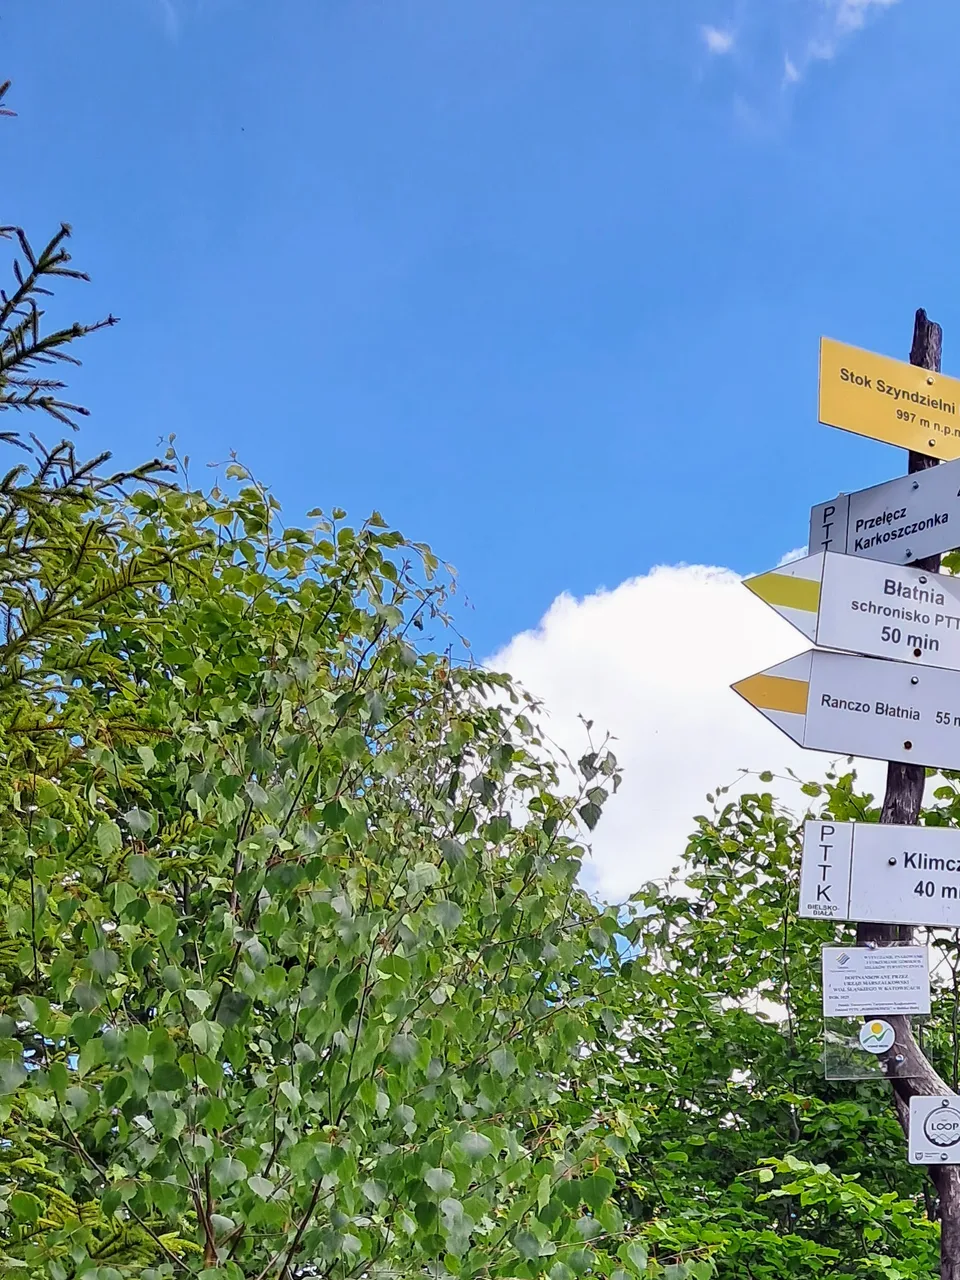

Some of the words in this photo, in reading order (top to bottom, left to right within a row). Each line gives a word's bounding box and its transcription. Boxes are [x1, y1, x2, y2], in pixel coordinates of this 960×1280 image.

[839, 367, 872, 390] Stok
[876, 379, 956, 416] Szyndzielni
[896, 409, 917, 424] 997
[919, 417, 931, 429] m
[821, 505, 836, 550] PTT
[854, 512, 949, 552] Karkoszczonka
[855, 506, 907, 533] Przełęcz
[883, 578, 946, 607] Błatnia
[851, 599, 931, 625] schronisko
[880, 626, 902, 644] 50
[906, 632, 940, 652] min
[820, 693, 871, 714] Ranczo
[874, 702, 921, 722] Błatnia
[935, 710, 951, 726] 55
[816, 824, 836, 902] PTTK
[913, 880, 936, 898] 40
[931, 1122, 960, 1131] LOOP
